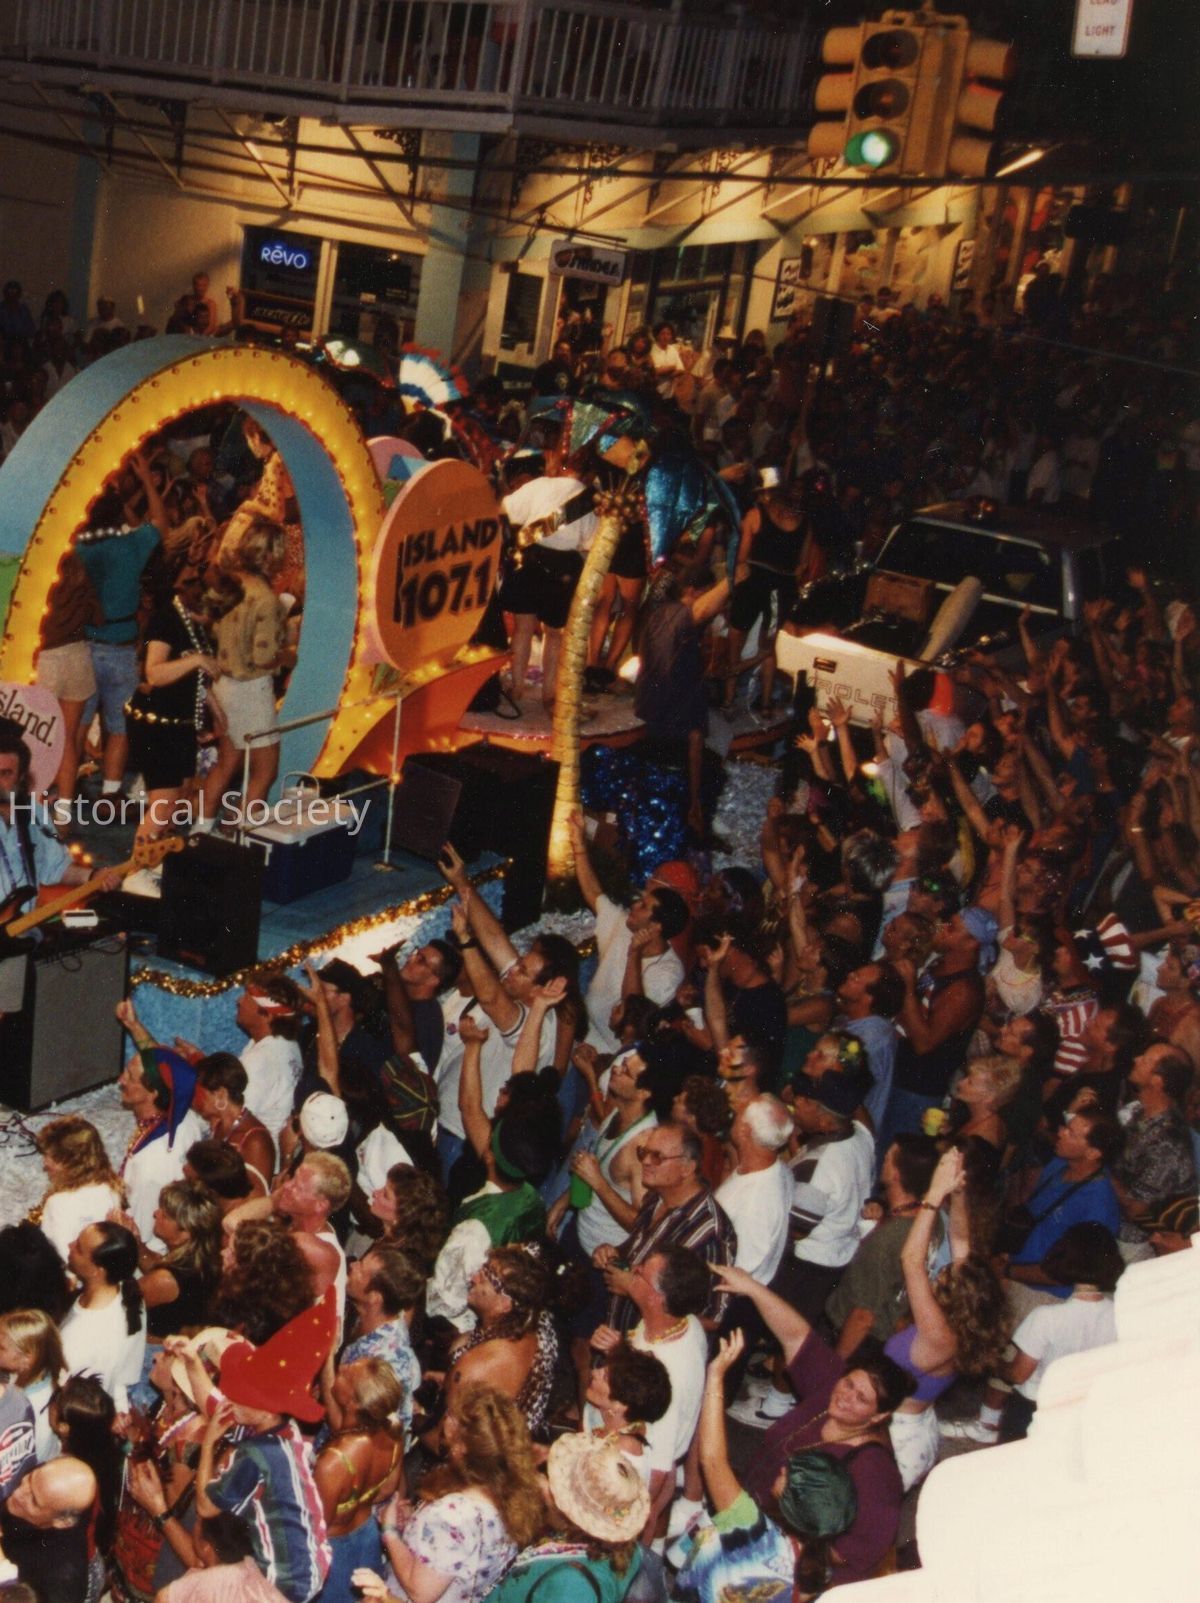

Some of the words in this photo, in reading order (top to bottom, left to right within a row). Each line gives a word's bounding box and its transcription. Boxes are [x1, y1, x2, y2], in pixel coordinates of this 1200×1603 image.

[1085, 25, 1116, 37] LIGHT
[404, 517, 499, 567] ISLAND
[402, 556, 492, 628] 107.1
